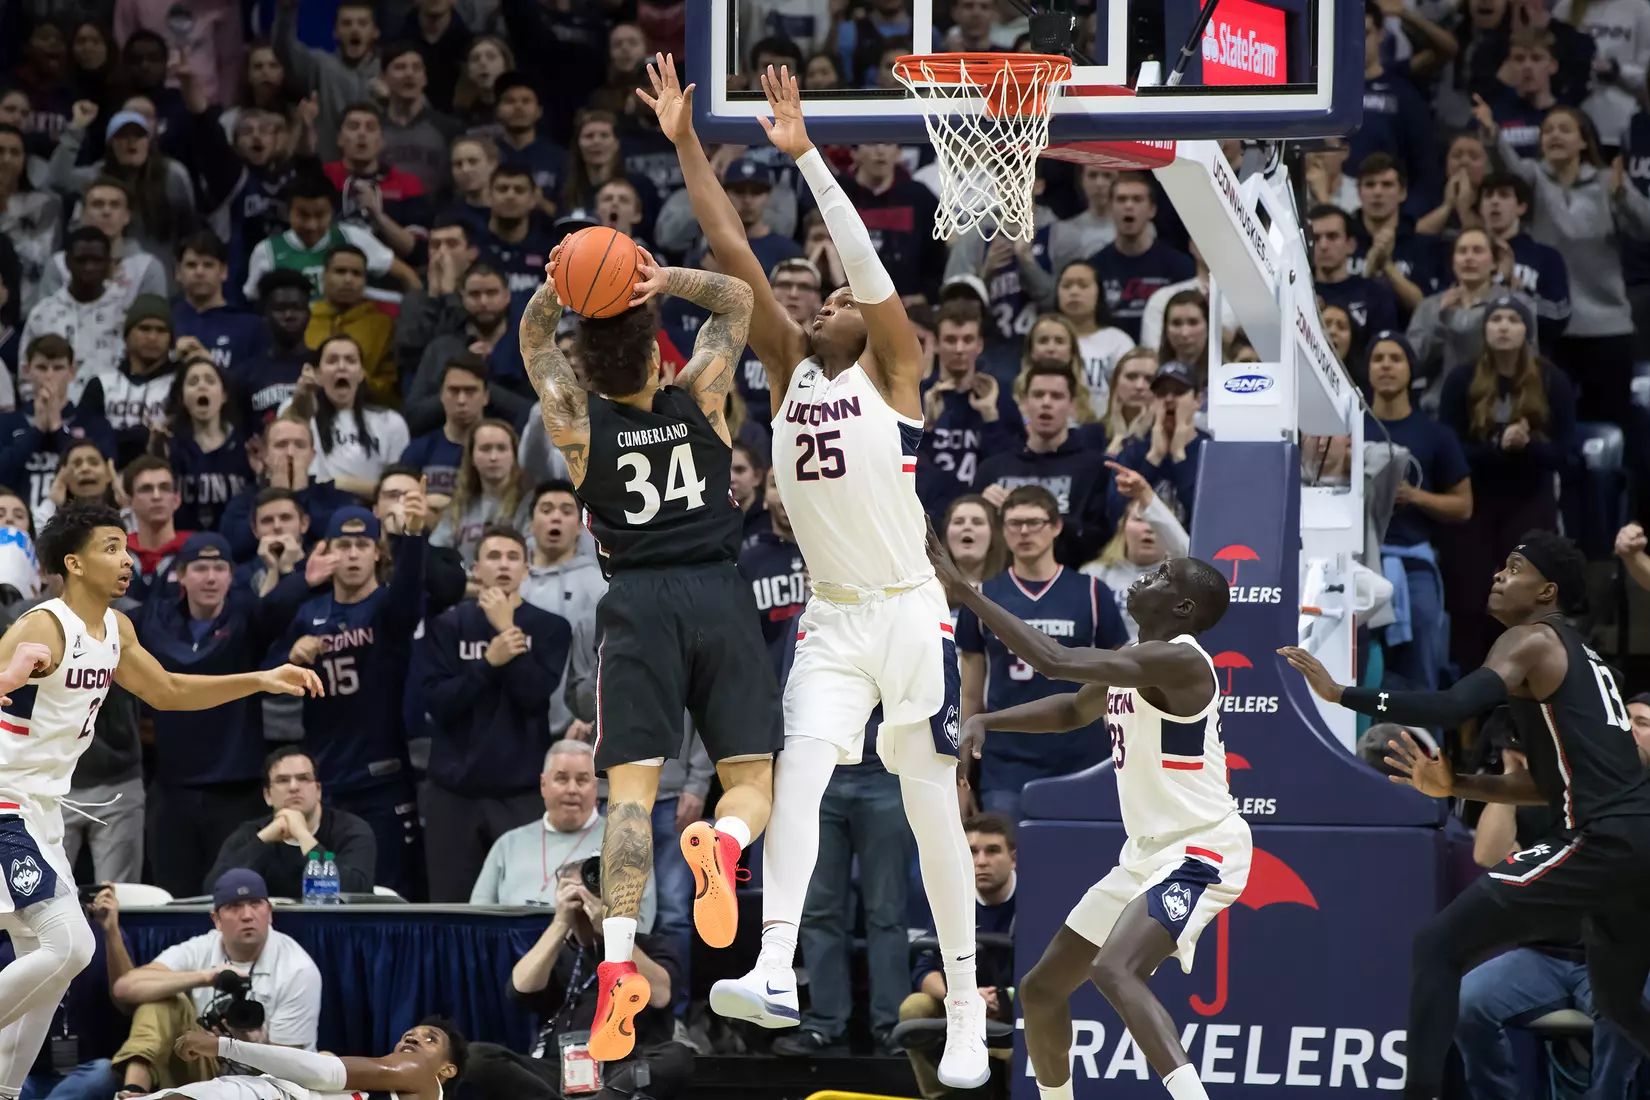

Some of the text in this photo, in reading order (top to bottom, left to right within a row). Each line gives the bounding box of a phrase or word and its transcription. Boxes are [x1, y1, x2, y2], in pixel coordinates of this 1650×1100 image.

[785, 396, 861, 427] UCONN
[617, 423, 688, 448] CUMBERLAND
[796, 430, 847, 481] 25
[617, 442, 706, 525] 34
[752, 572, 805, 611] UCO
[1228, 586, 1282, 604] ELERS
[320, 627, 375, 654] CONN
[322, 656, 360, 697] 15
[1217, 695, 1279, 714] VELERS
[1588, 659, 1631, 732] 13
